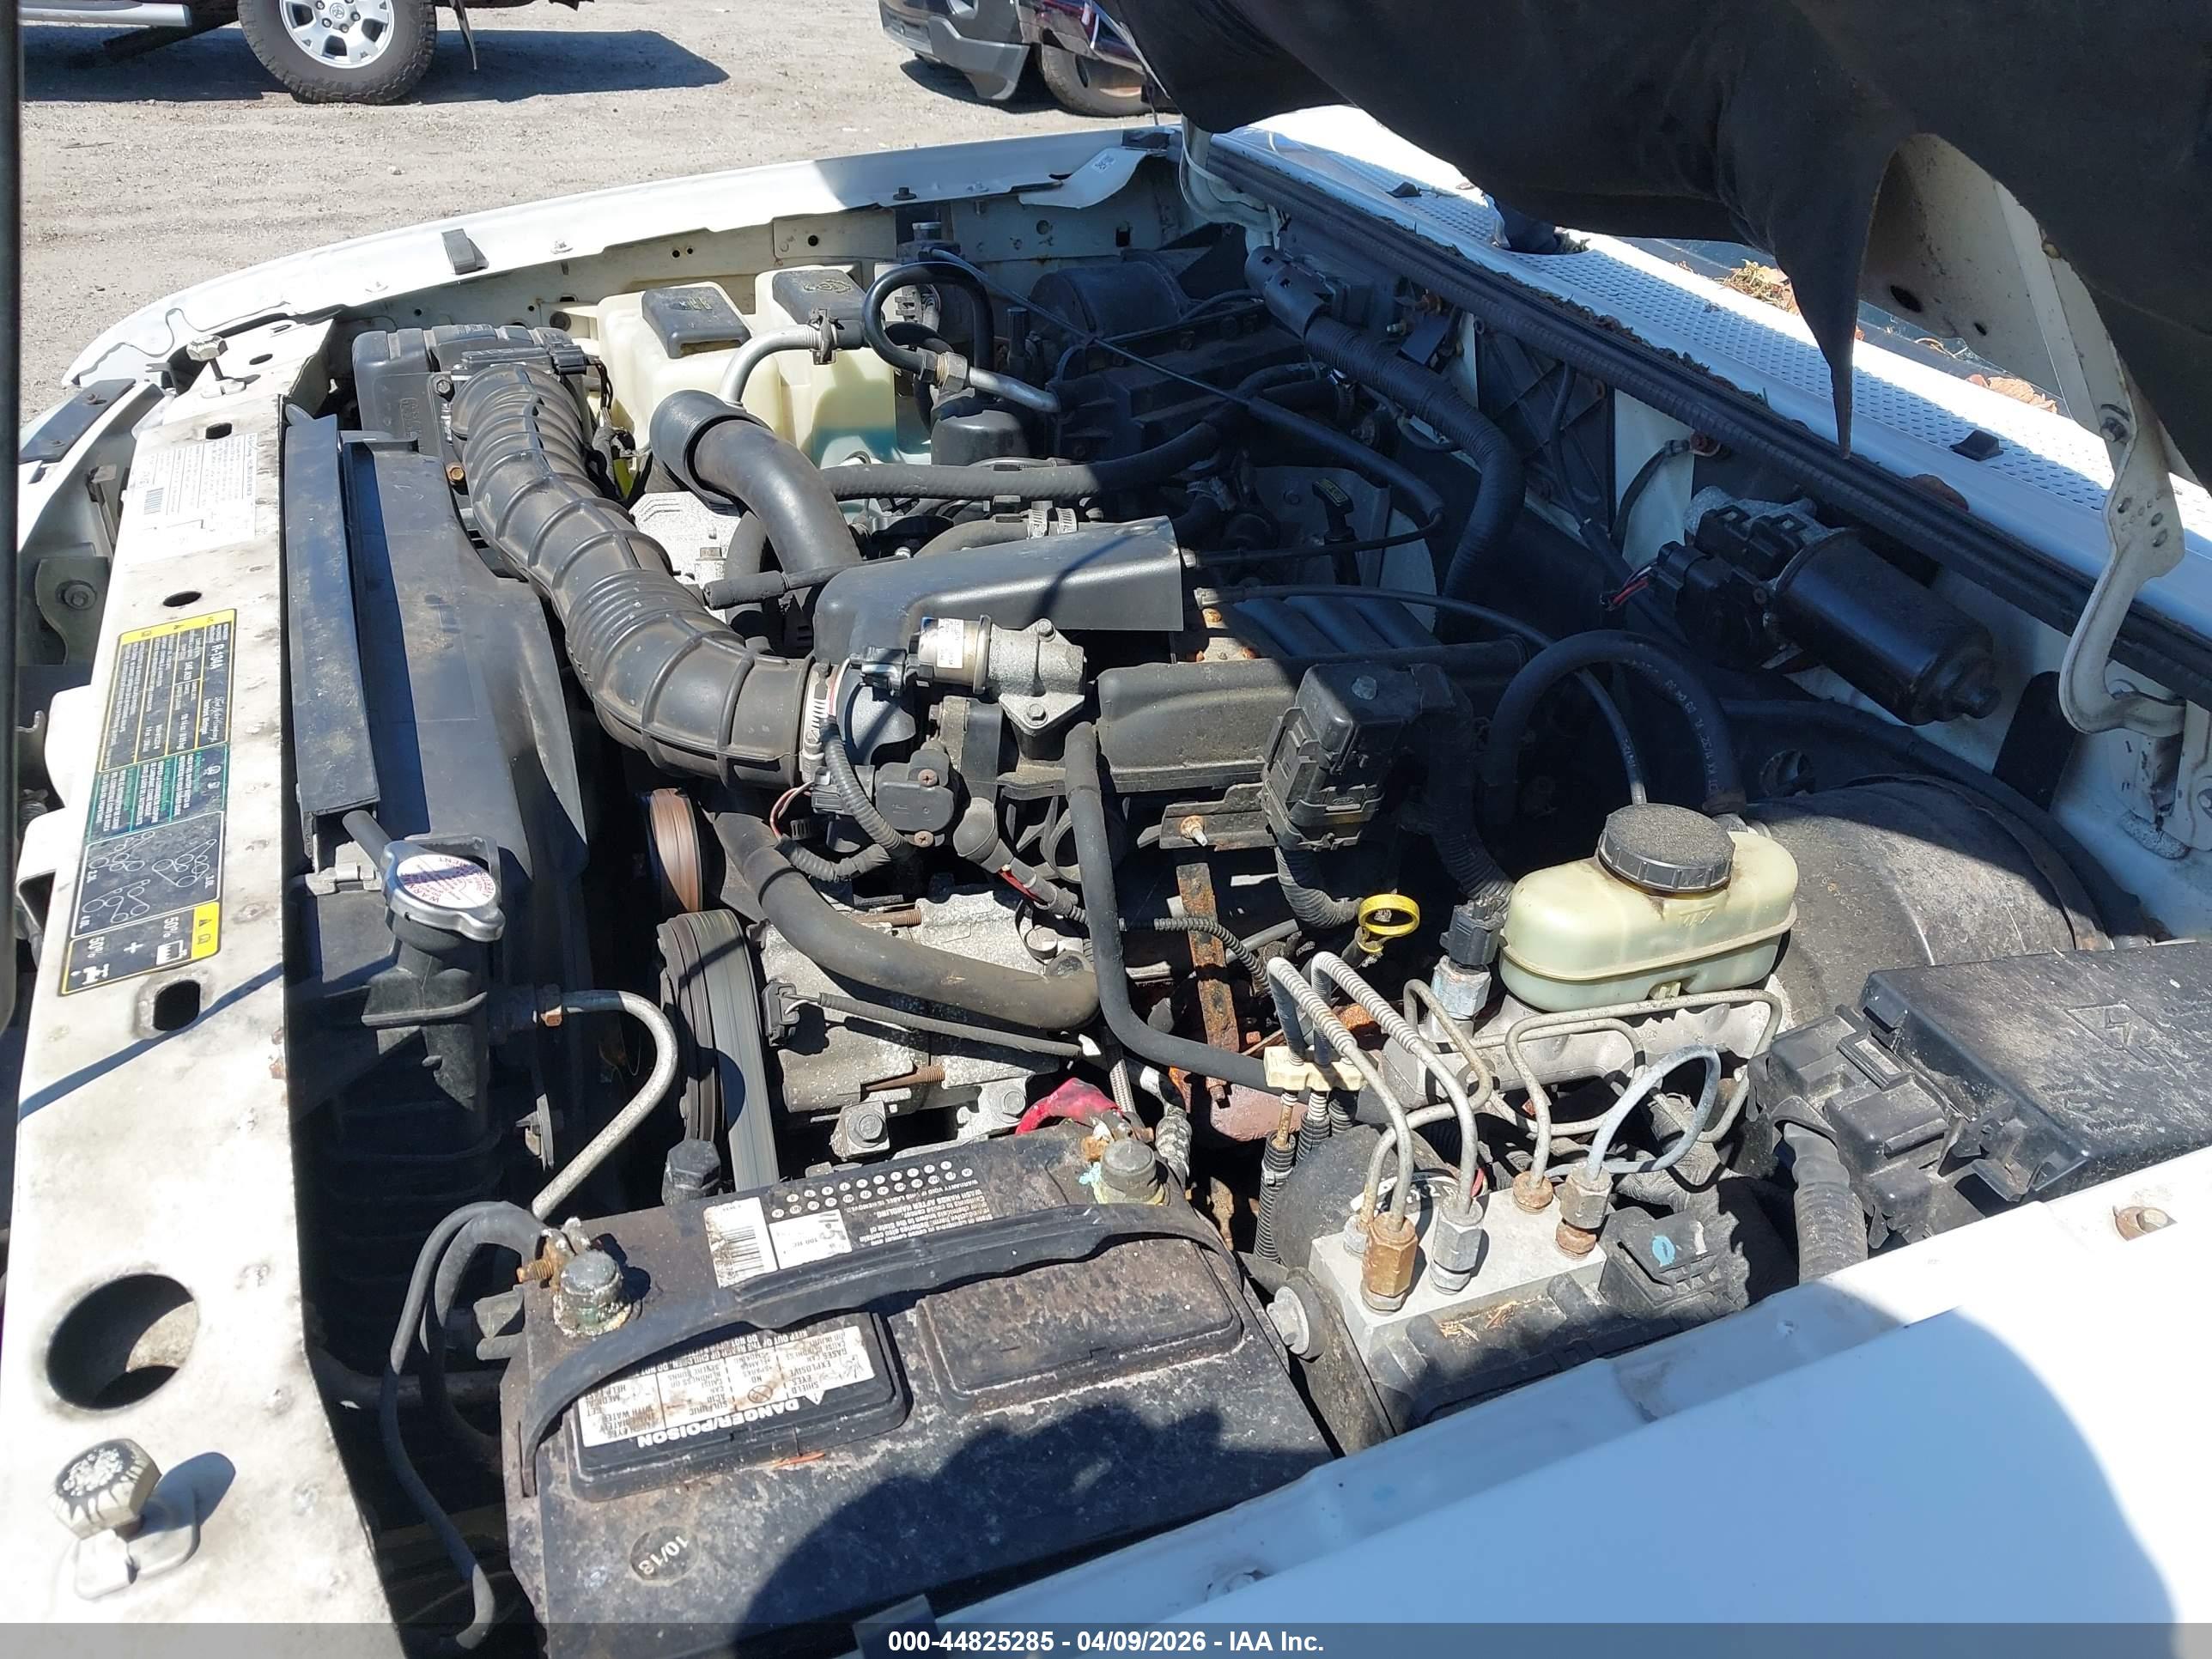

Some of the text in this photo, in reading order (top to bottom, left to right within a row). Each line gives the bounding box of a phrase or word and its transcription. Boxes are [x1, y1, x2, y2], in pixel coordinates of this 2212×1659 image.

[209, 643, 224, 670] R-134A
[162, 915, 179, 939] 50%
[86, 935, 104, 959] 50%
[927, 1186, 943, 1195] VOID
[943, 1178, 979, 1192] WARRANTY
[872, 1188, 982, 1218] WASH HANDS AFTER HANDLING.
[936, 1205, 969, 1218] chemicals
[772, 1334, 788, 1345] OUT
[788, 1328, 808, 1341] KEEP
[746, 1340, 761, 1352] THE
[761, 1337, 773, 1347] OF
[822, 1346, 848, 1360] GASES
[788, 1358, 831, 1376] EXPLOSIVE
[750, 1374, 762, 1383] NO
[790, 1381, 818, 1394] SHIELD
[706, 1392, 726, 1403] ACID
[635, 1397, 799, 1449] DANGER/POISON
